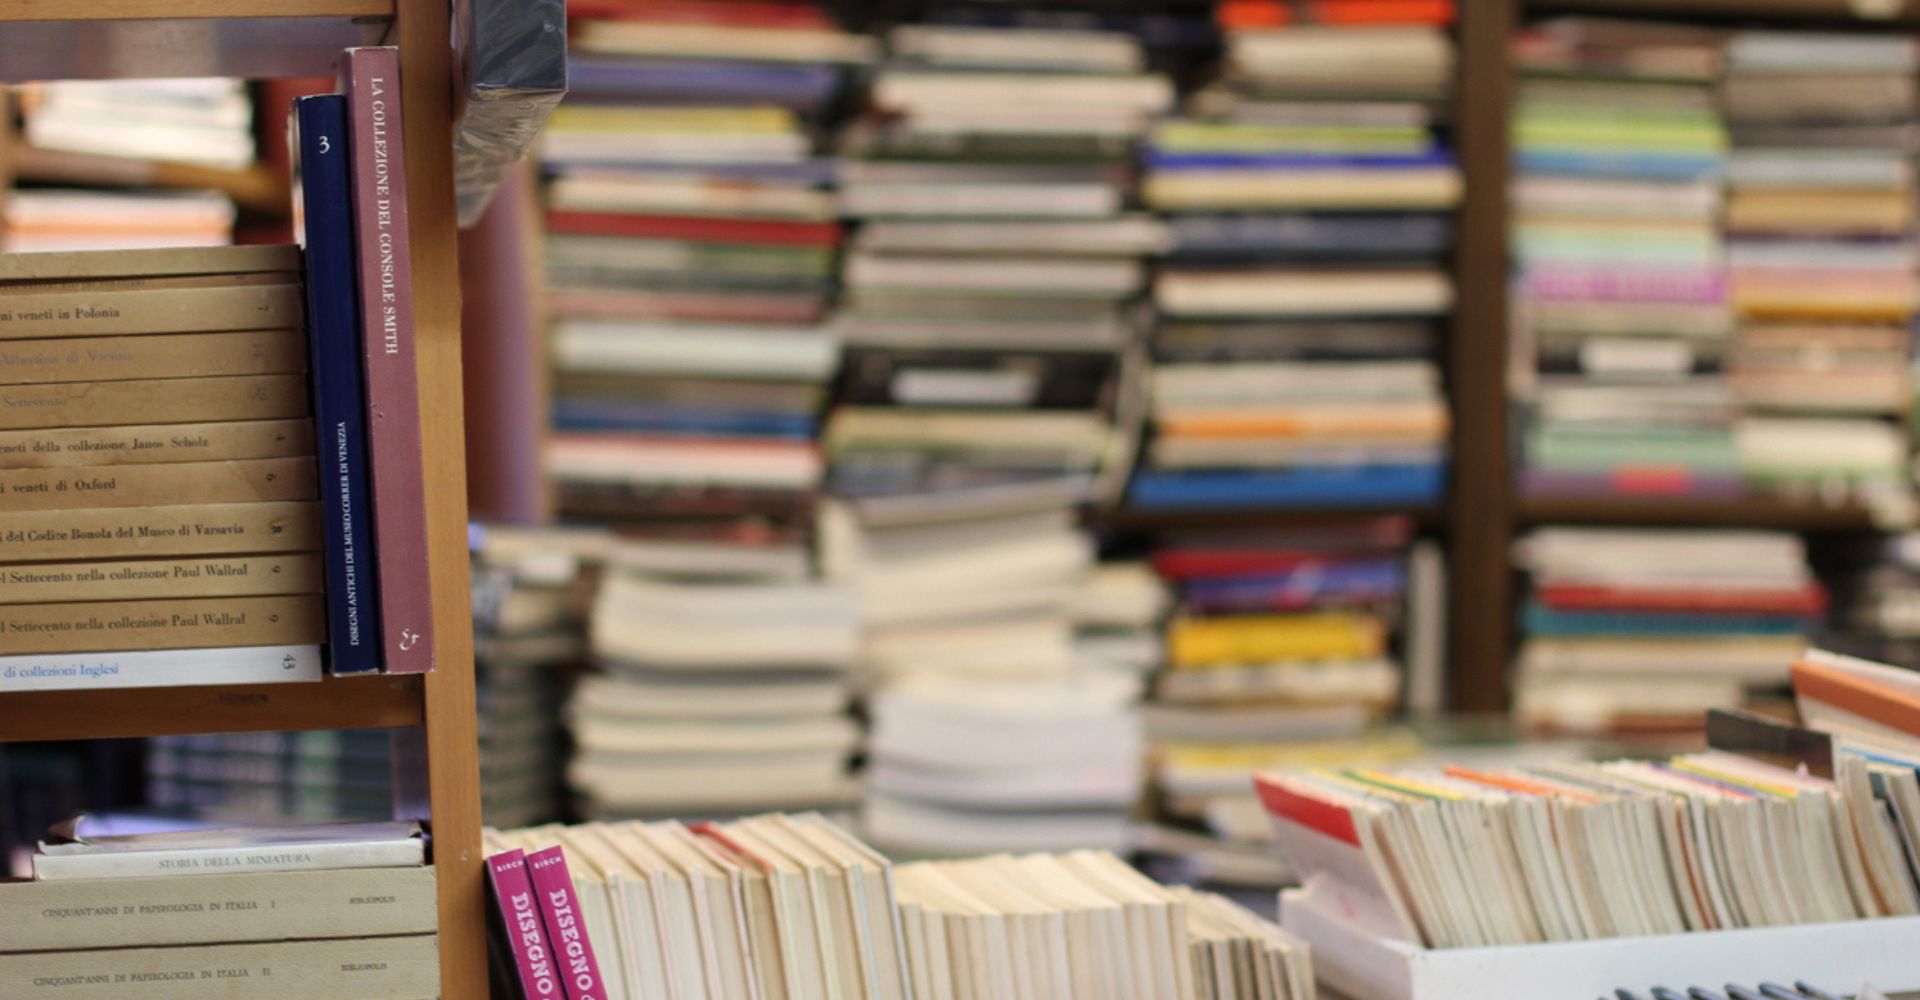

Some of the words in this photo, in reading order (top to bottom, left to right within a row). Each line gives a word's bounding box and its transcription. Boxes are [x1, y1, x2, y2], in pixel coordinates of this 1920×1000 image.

[371, 77, 384, 100] LA
[319, 135, 331, 154] 3
[372, 101, 390, 196] COLLEZIONE
[377, 199, 392, 230] DEL
[379, 233, 396, 303] CONSOLE
[18, 308, 53, 320] veneti
[58, 308, 70, 319] in
[75, 307, 121, 319] Polonia
[383, 306, 398, 355] SMITH
[33, 440, 61, 452] della
[67, 438, 125, 451] collezione
[132, 437, 164, 450] Janos
[171, 437, 209, 448] Scholz
[337, 421, 348, 462] VENEZIA
[339, 463, 349, 474] DI
[12, 481, 48, 493] veneti
[55, 479, 68, 491] di
[75, 478, 117, 491] Oxford
[340, 475, 351, 513] CORRER
[6, 530, 25, 542] del
[28, 528, 68, 541] Codice
[71, 527, 112, 540] Bonola
[116, 526, 134, 538] del
[138, 525, 175, 537] Museo
[178, 524, 191, 536] di
[194, 523, 245, 535] Varsavia
[342, 513, 353, 546] MUSEO
[344, 546, 355, 564] DEL
[9, 570, 73, 583] Settecento
[76, 568, 106, 581] nella
[110, 566, 169, 580] collezione
[173, 565, 201, 577] Paul
[205, 564, 248, 576] Wallraf
[346, 565, 357, 607] ANTICHI
[9, 620, 72, 632] Settecento
[75, 618, 104, 630] nella
[108, 617, 168, 629] collezione
[172, 615, 199, 627] Paul
[203, 613, 246, 626] Wallraf
[349, 607, 359, 646] DISEGNI
[4, 665, 16, 678] di
[19, 664, 76, 678] collezioni
[80, 662, 119, 678] Inglesi
[281, 653, 297, 670] 43
[158, 857, 199, 870] STORIA
[204, 855, 241, 867] DELLA
[247, 852, 312, 865] MINIATURA
[496, 859, 525, 872] BIRCH
[534, 856, 562, 869] BIRCH
[123, 906, 135, 915] DI
[139, 903, 205, 914] PAPIROLOGIA
[209, 903, 221, 912] IN
[225, 901, 258, 911] ITALIA
[511, 891, 553, 995] DISEGNO
[549, 888, 593, 991] DISEGNO
[114, 974, 126, 983] DI
[130, 971, 195, 983] PAPIROLOGIA
[201, 970, 213, 979] IN
[217, 968, 249, 978] ITALIA
